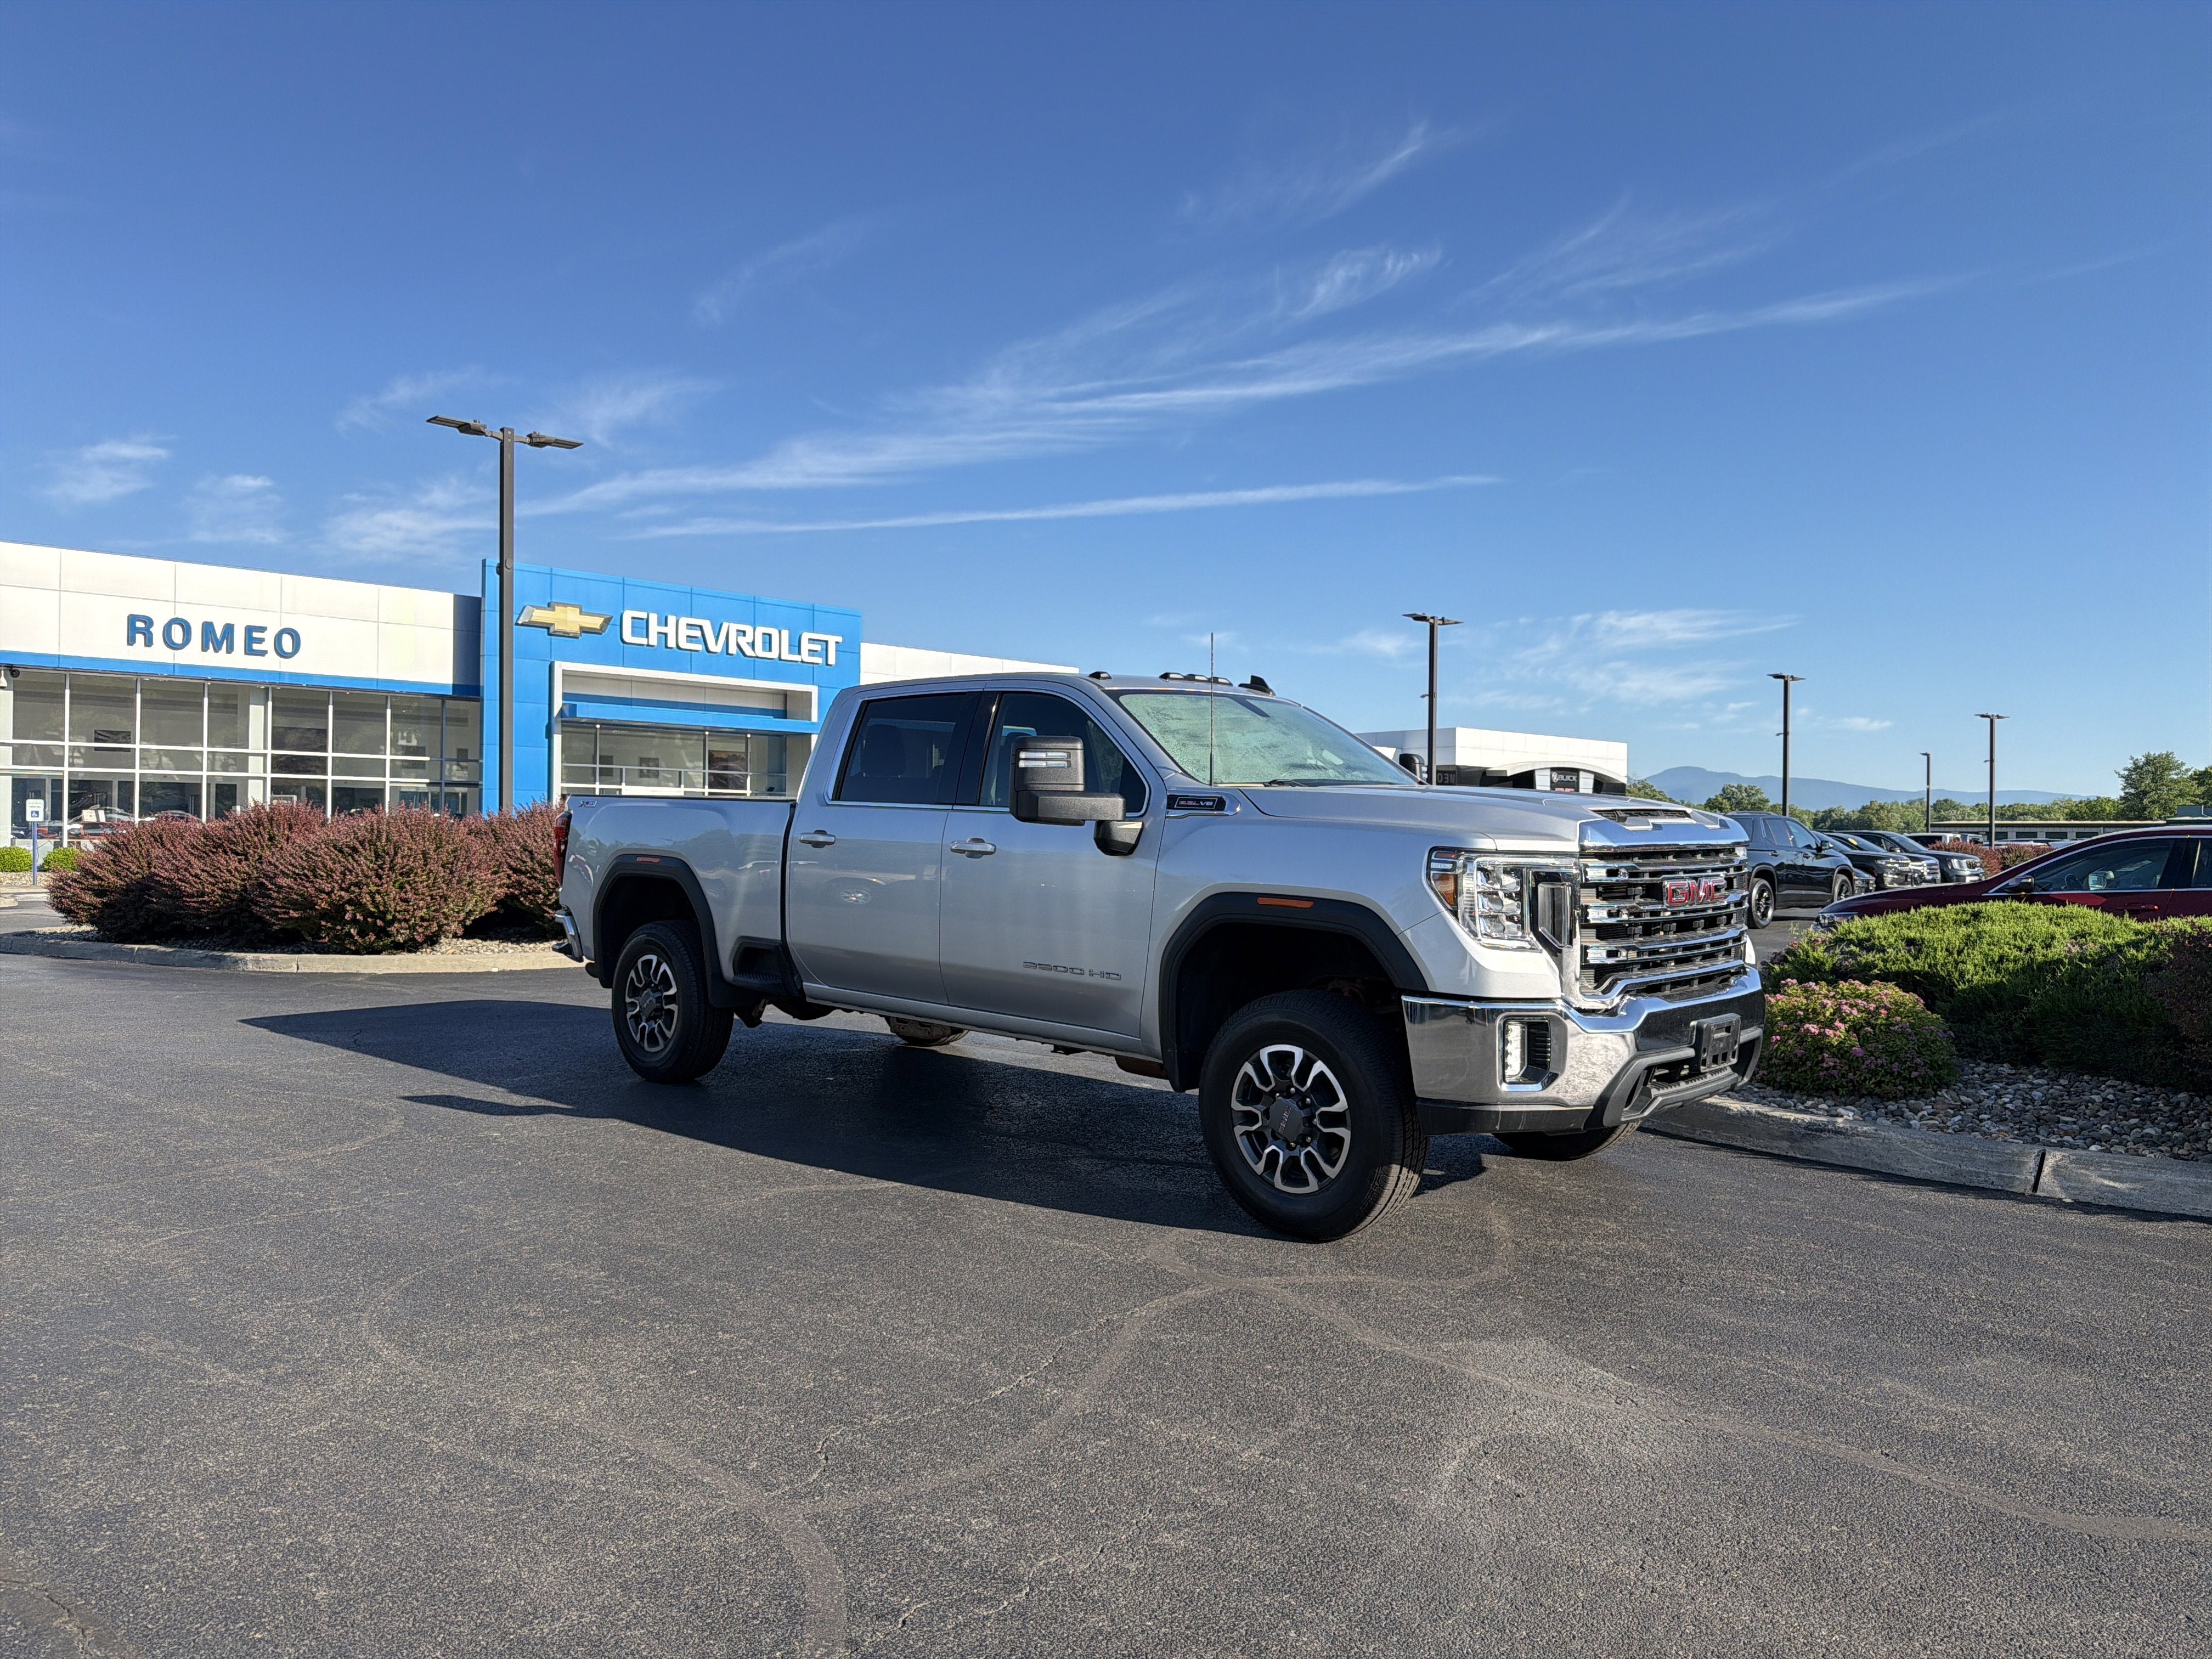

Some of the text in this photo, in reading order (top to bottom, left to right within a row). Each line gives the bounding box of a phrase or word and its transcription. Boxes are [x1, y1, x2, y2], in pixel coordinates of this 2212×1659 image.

[127, 614, 301, 659] ROMEO
[620, 610, 843, 667] CHEVROLET
[1558, 774, 1577, 783] BUICK
[1665, 878, 1726, 905] GMC
[1088, 969, 1122, 981] HD
